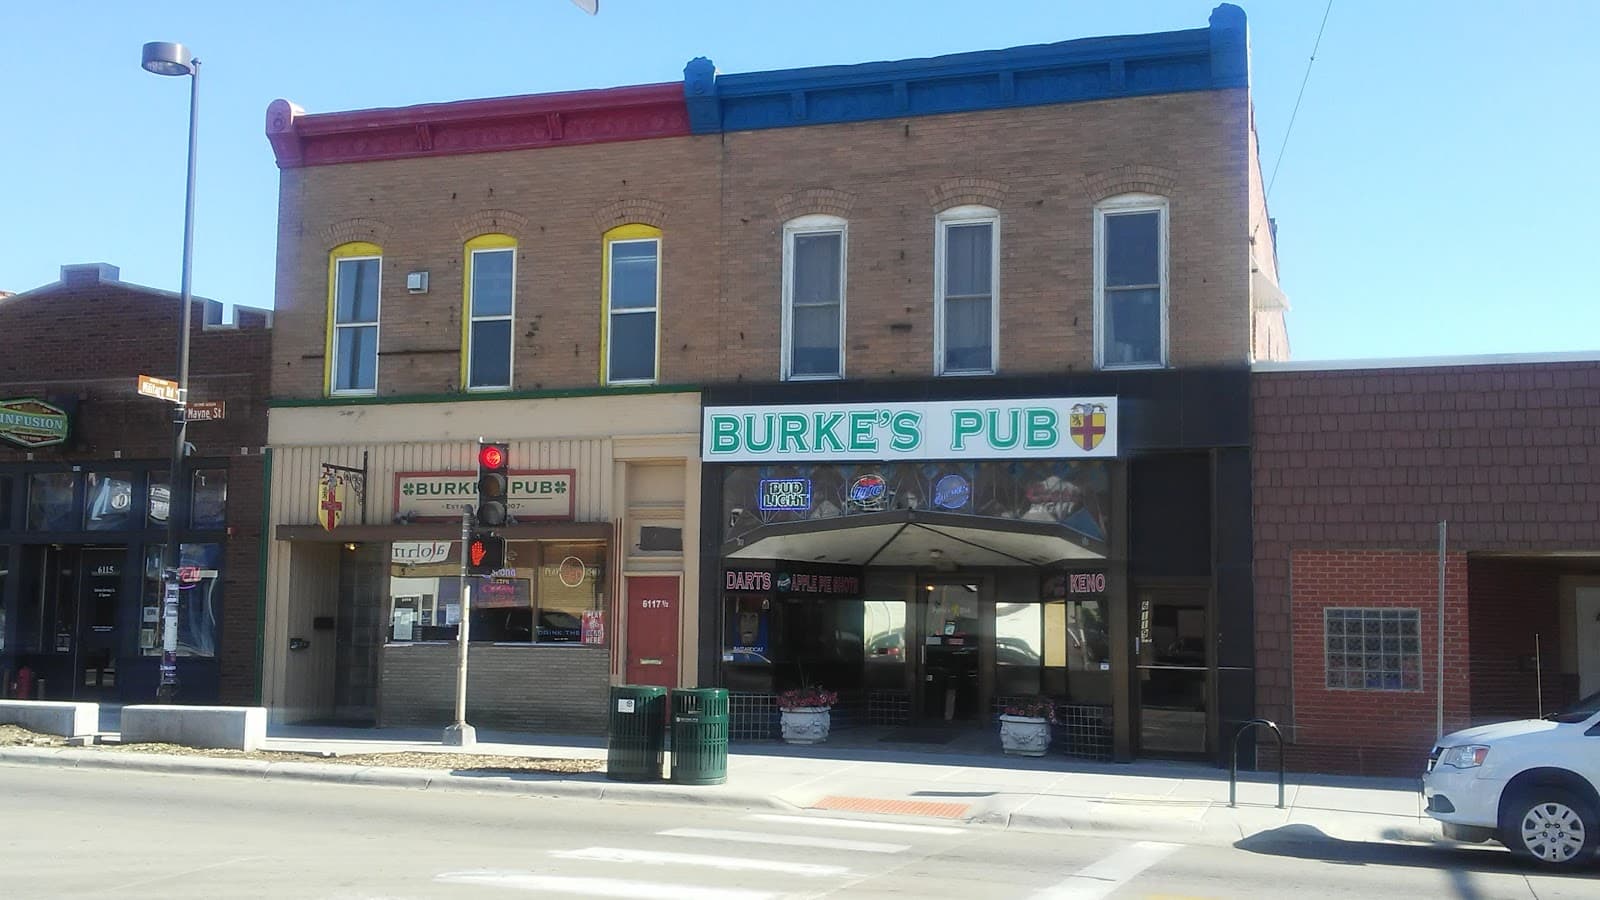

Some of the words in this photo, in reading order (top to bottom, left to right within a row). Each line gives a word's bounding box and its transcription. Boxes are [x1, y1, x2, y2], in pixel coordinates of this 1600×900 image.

[166, 386, 174, 398] Rd
[187, 407, 210, 420] Mayne
[213, 407, 221, 418] St
[710, 410, 921, 454] BURKE'S
[950, 407, 1059, 451] PUB
[512, 481, 553, 494] PUB
[769, 482, 803, 494] BUD
[763, 494, 809, 507] LIGHT
[97, 566, 114, 574] 6115
[726, 571, 771, 590] DARTS
[791, 573, 818, 592] APPLE
[818, 575, 832, 593] PIE
[1070, 573, 1106, 593] KENO
